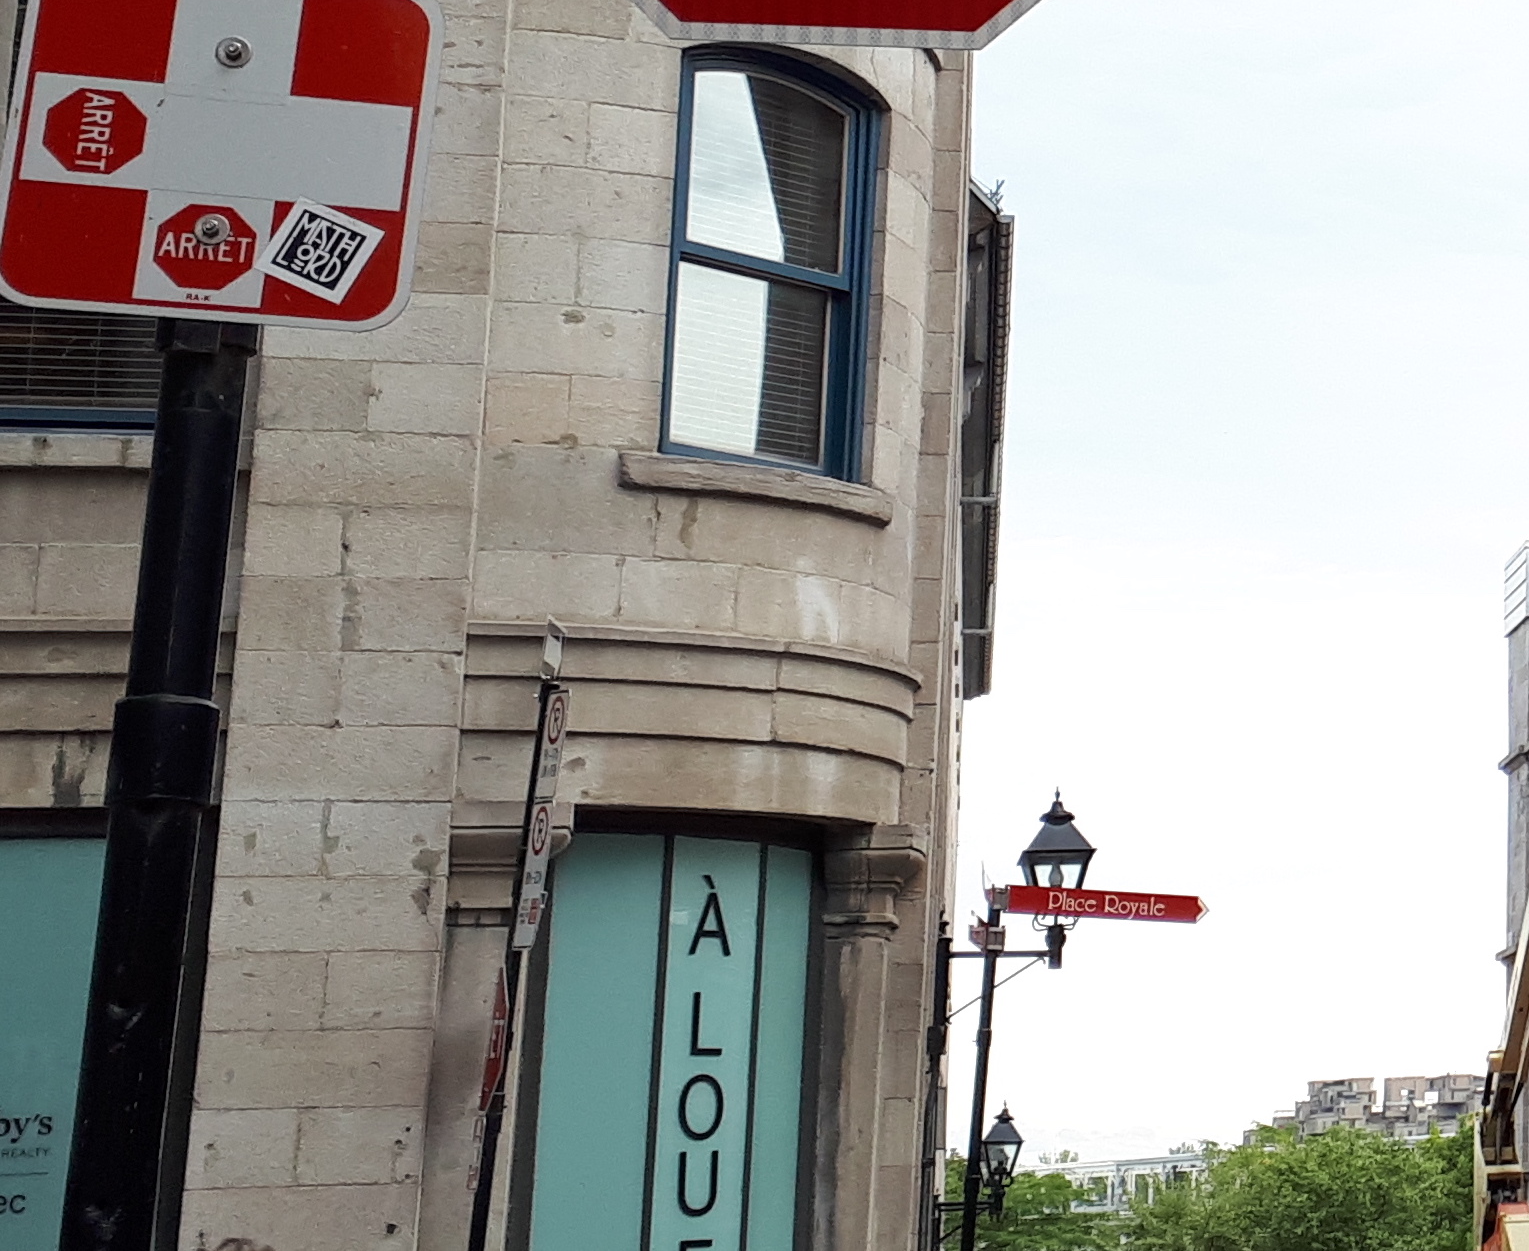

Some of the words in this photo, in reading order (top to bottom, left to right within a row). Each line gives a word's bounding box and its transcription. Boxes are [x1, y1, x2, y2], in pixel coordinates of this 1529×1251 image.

[75, 91, 115, 171] ARRÊT
[293, 213, 362, 261] MATH
[688, 874, 731, 957] À
[1048, 891, 1097, 913] Place
[1104, 894, 1165, 920] Royale
[677, 991, 724, 1251] LOU
